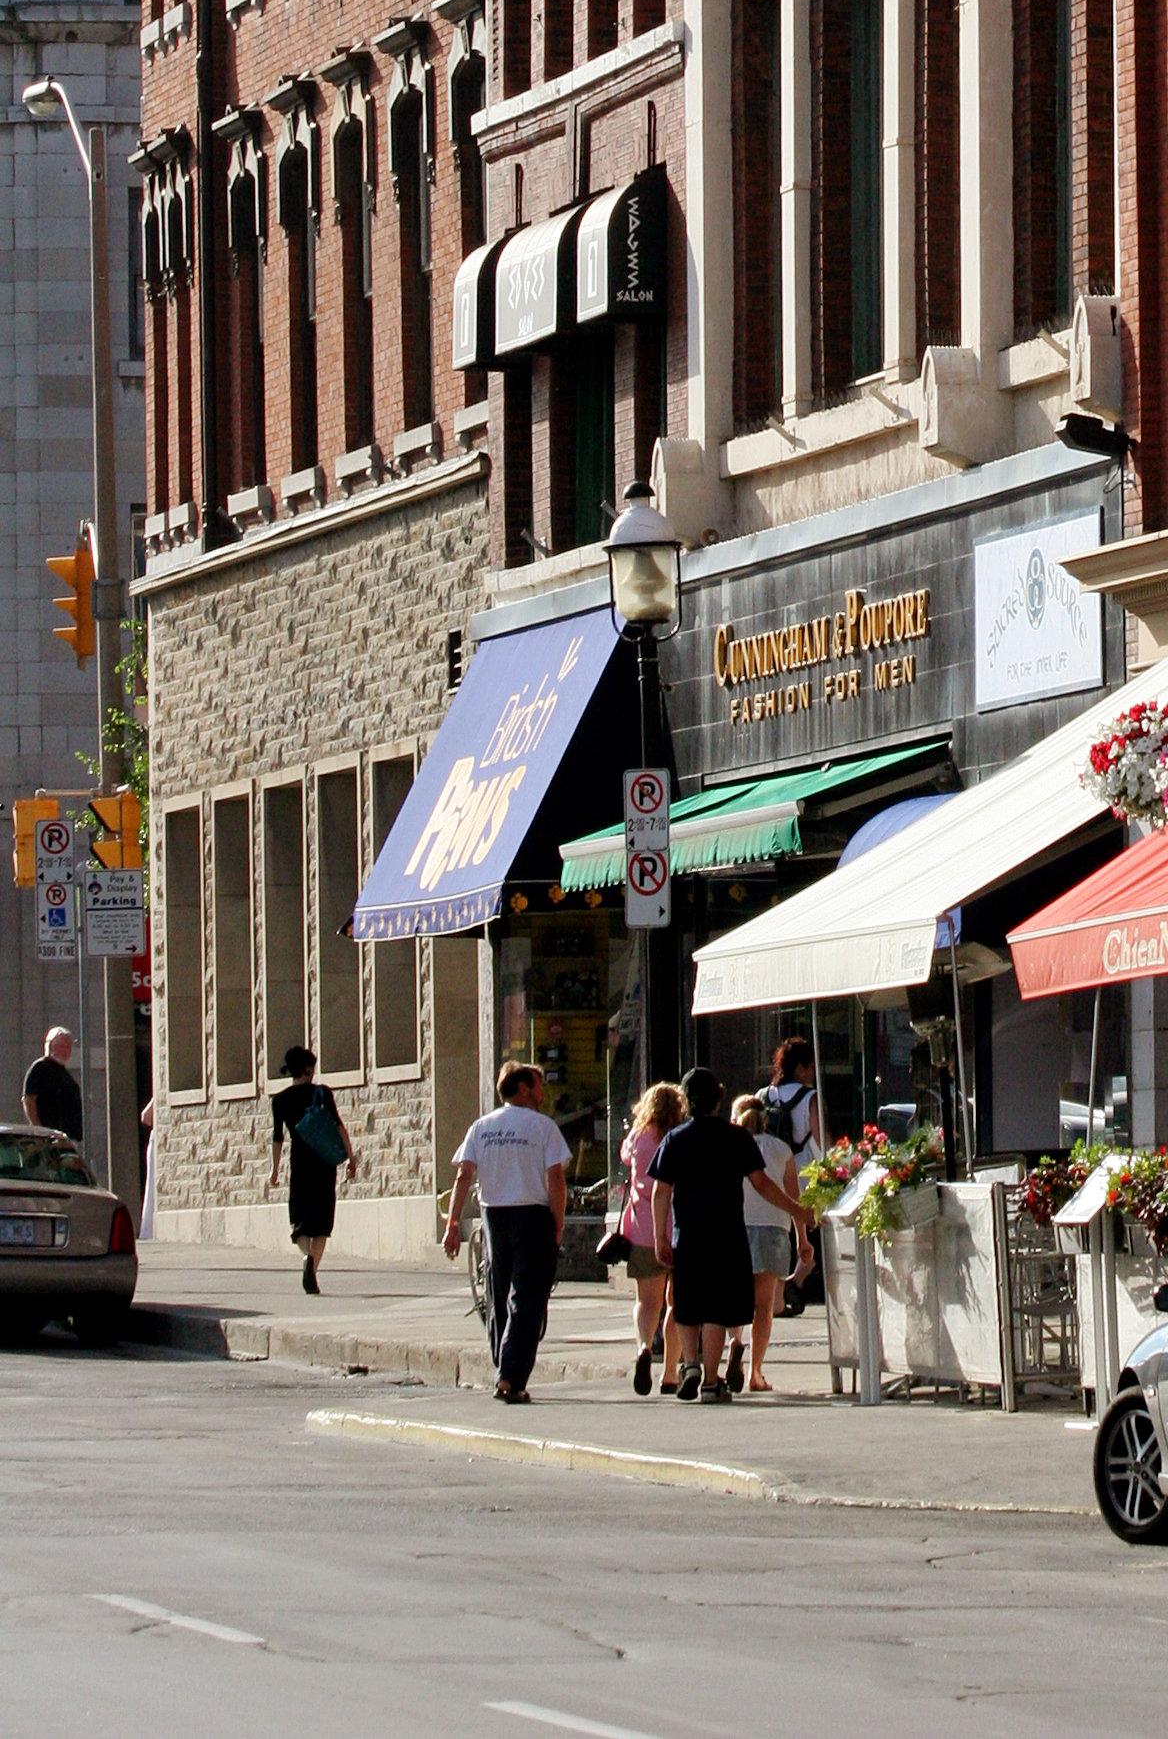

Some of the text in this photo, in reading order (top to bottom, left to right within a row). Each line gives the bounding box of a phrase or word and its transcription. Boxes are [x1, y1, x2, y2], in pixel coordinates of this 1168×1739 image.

[616, 289, 654, 303] SALON
[833, 612, 846, 659] &
[730, 654, 917, 726] FASHION FOR MEN
[110, 874, 135, 884] Pay &
[107, 884, 138, 893] Display
[92, 896, 137, 906] Parking
[59, 945, 75, 957] FINE
